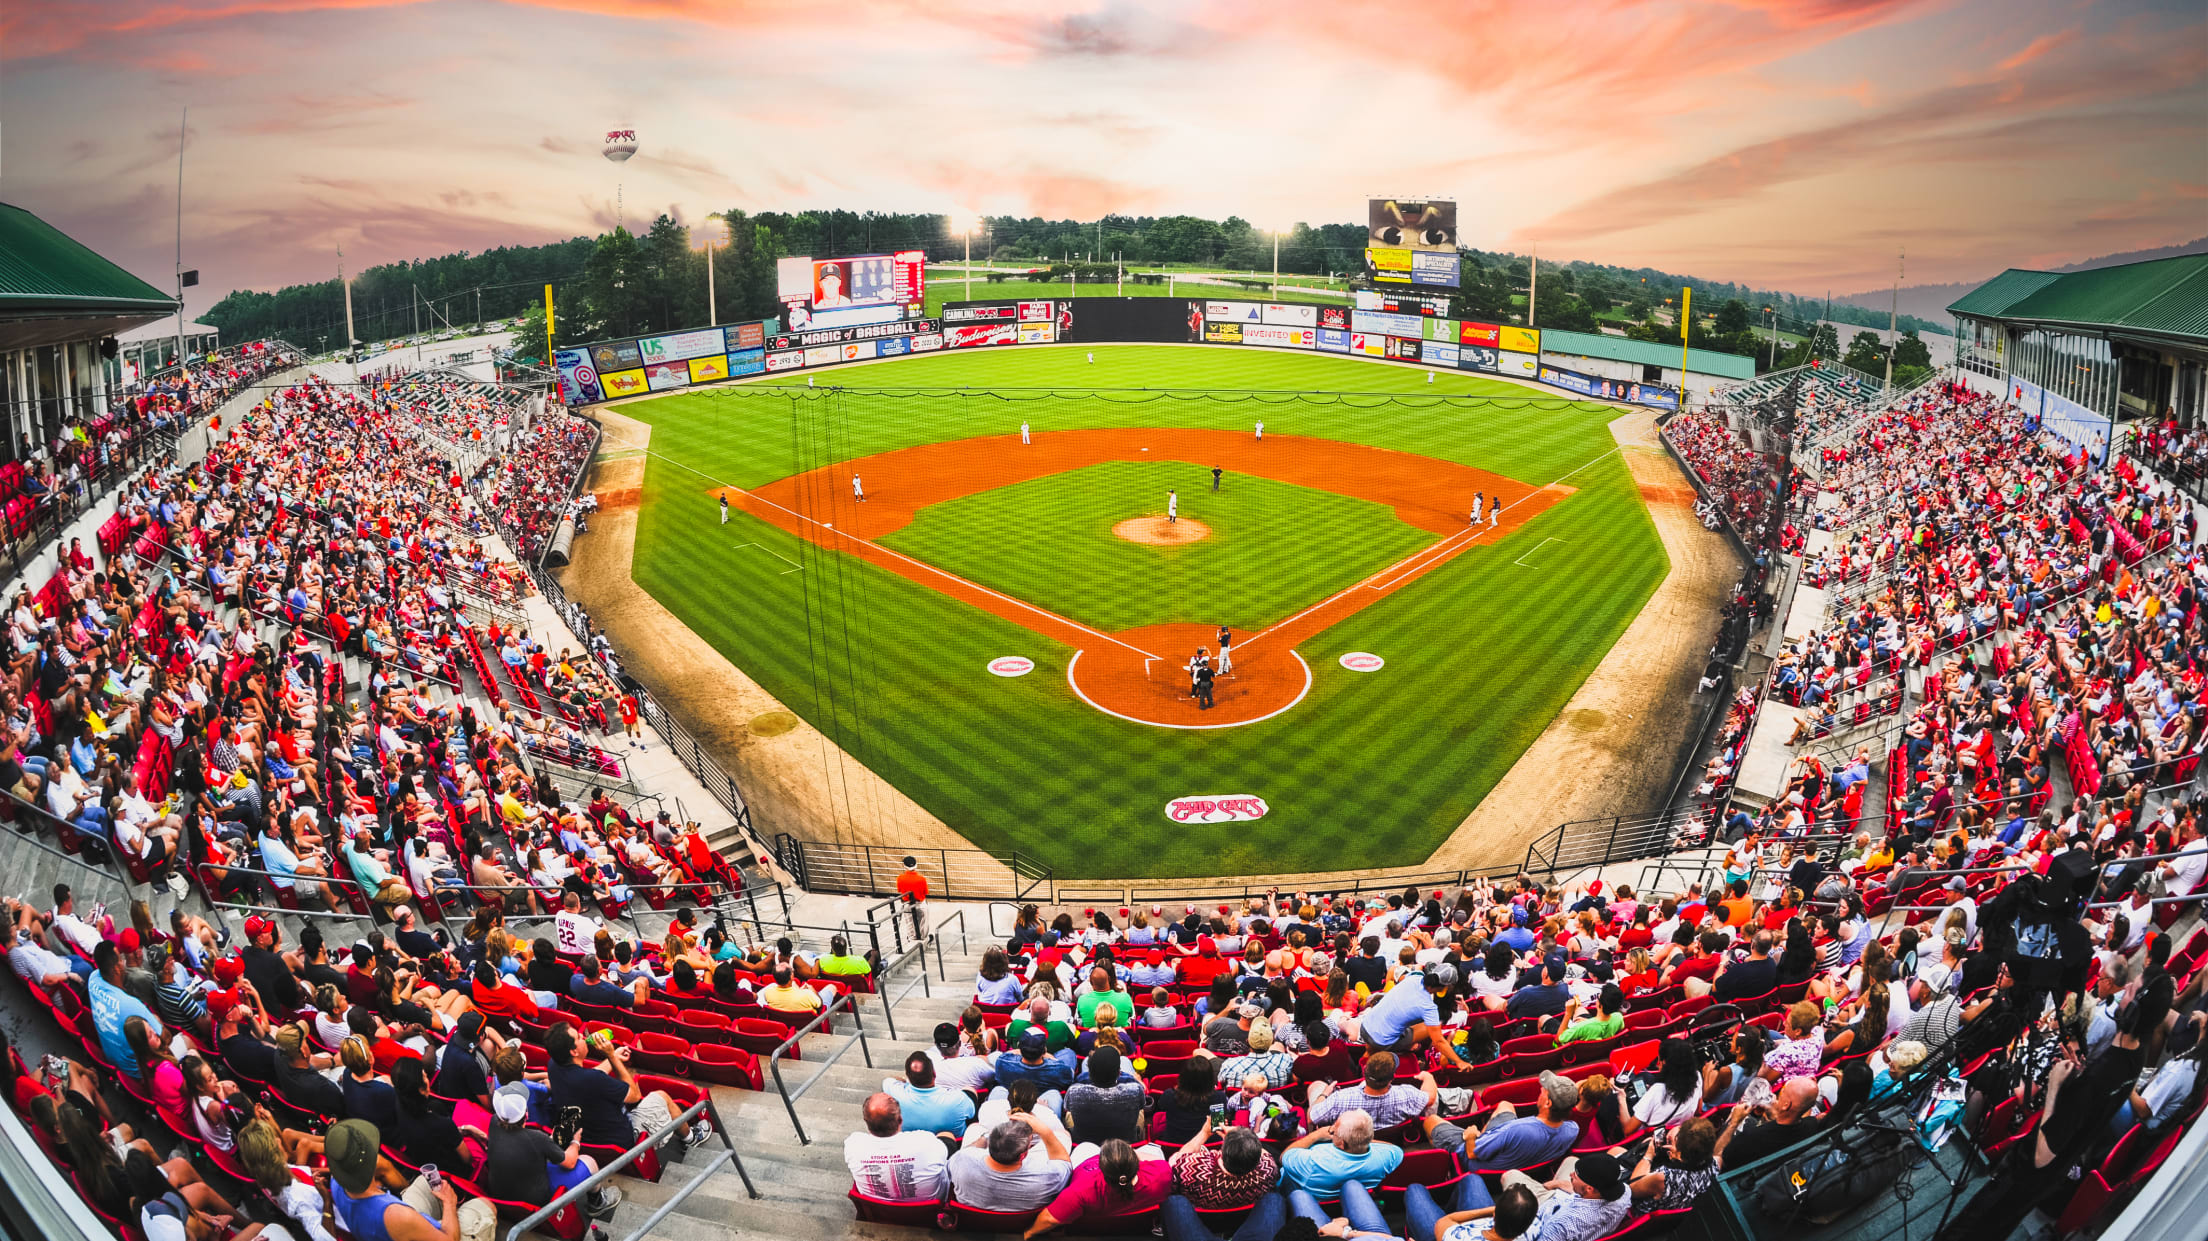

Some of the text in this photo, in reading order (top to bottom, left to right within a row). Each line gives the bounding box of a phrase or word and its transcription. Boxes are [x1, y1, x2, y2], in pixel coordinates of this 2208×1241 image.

[946, 309, 974, 319] CAROLINA
[1323, 308, 1344, 318] 98.5
[801, 330, 841, 345] MAGIC
[843, 328, 853, 340] of
[856, 323, 916, 339] BASEBALL
[950, 323, 1016, 347] Budweiser
[1244, 329, 1288, 339] INVENTED
[647, 354, 666, 363] FOODS
[558, 928, 577, 947] 22
